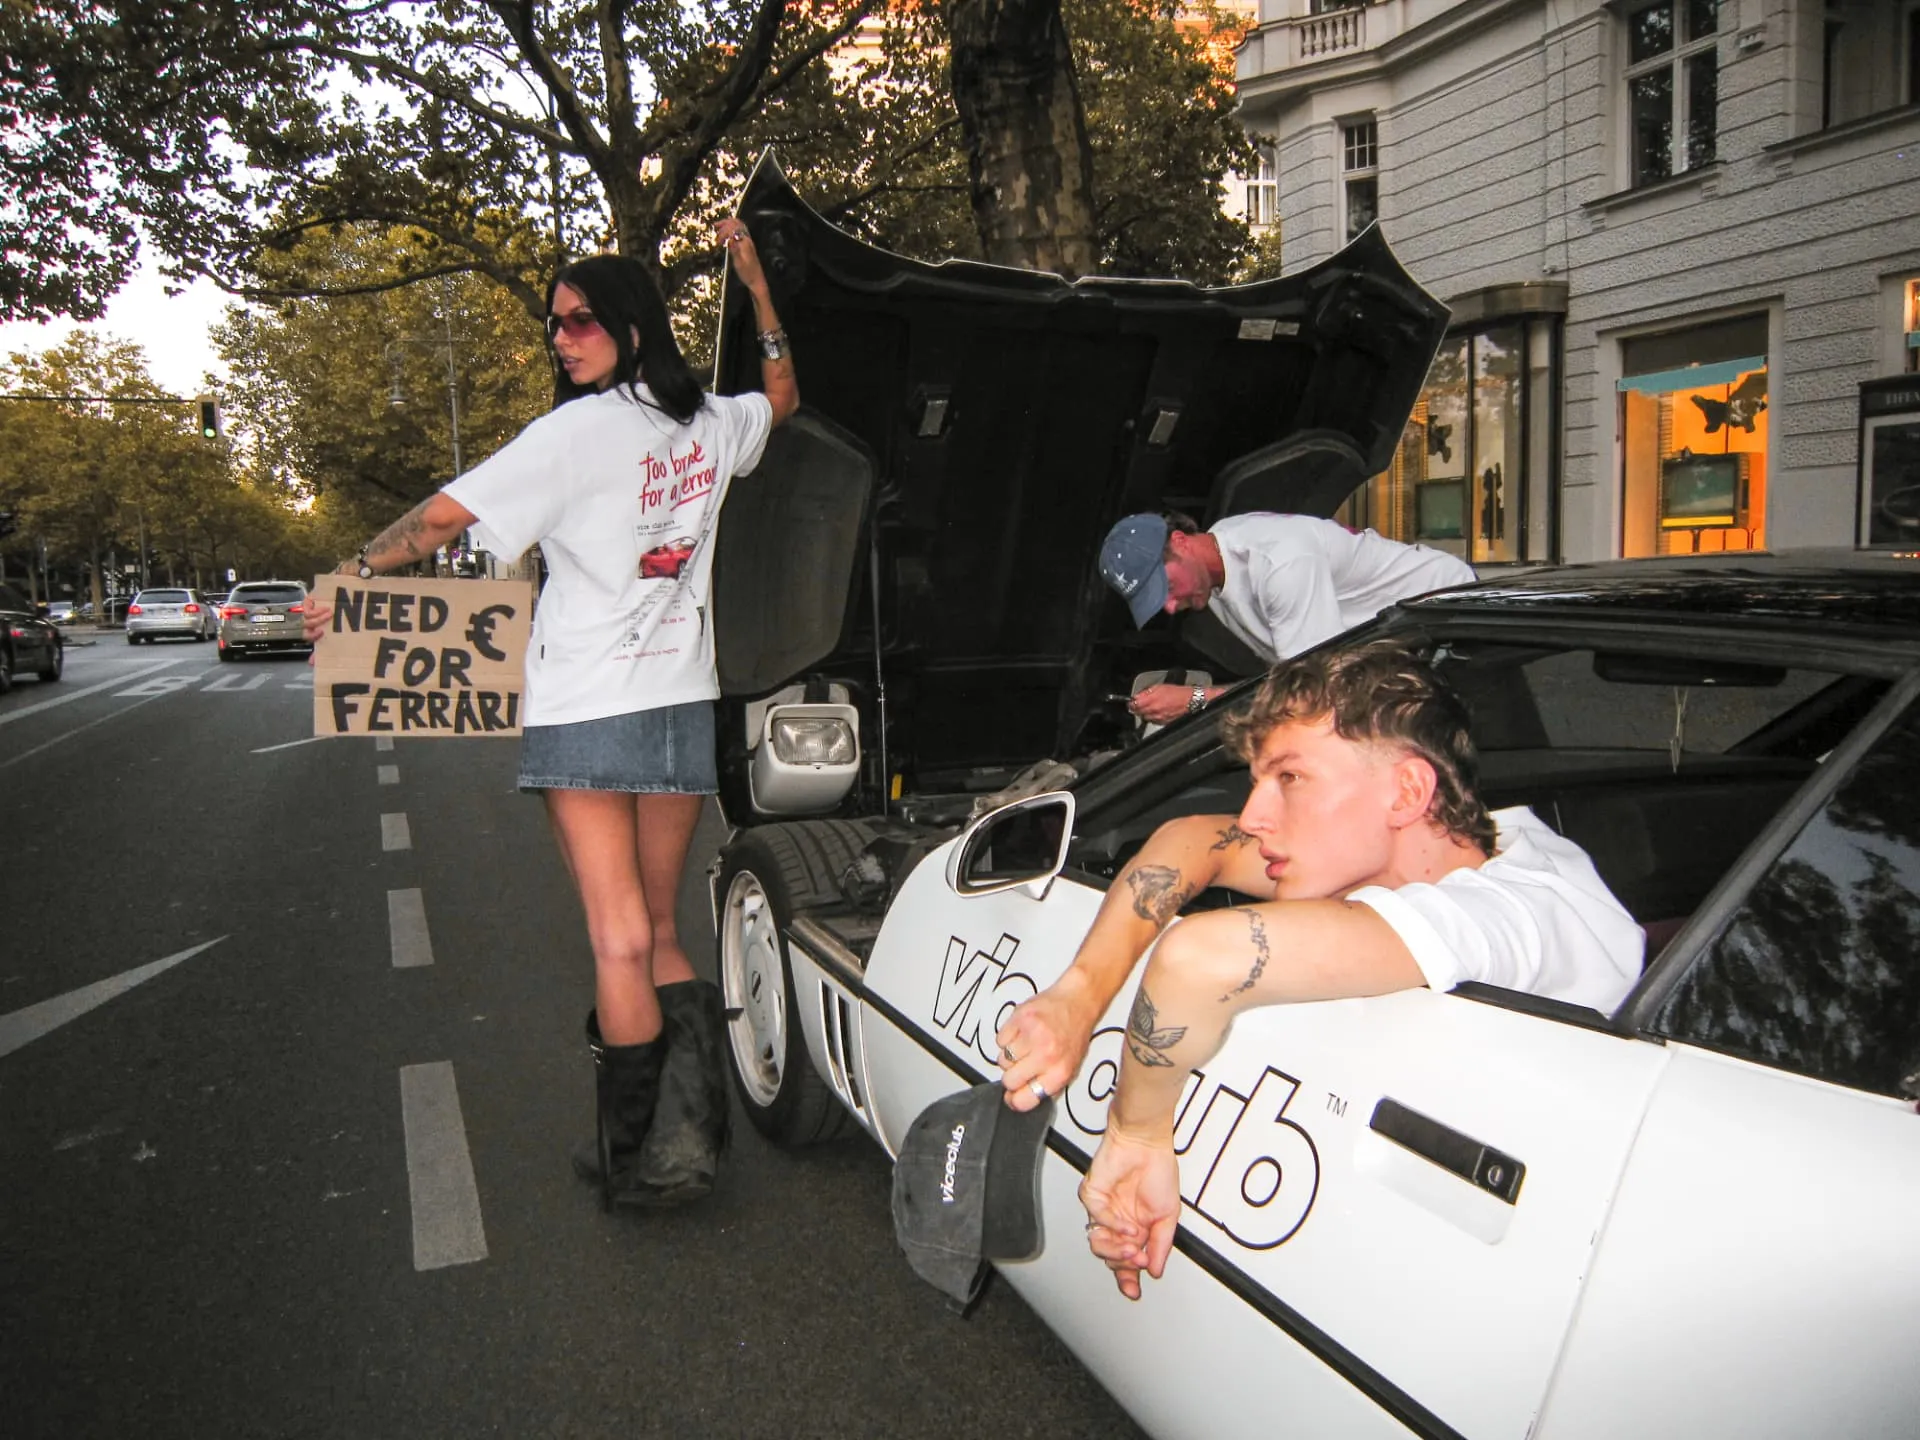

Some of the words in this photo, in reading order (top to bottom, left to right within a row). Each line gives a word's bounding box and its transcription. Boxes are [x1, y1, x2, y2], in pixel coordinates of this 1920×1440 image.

[639, 451, 668, 486] too
[638, 483, 665, 515] for
[670, 484, 678, 501] a
[332, 587, 449, 633] NEED
[465, 604, 516, 662] €
[374, 637, 473, 689] FOR
[331, 683, 519, 734] FERRARI
[1326, 1092, 1348, 1118] TM
[940, 1124, 965, 1203] viceclub
